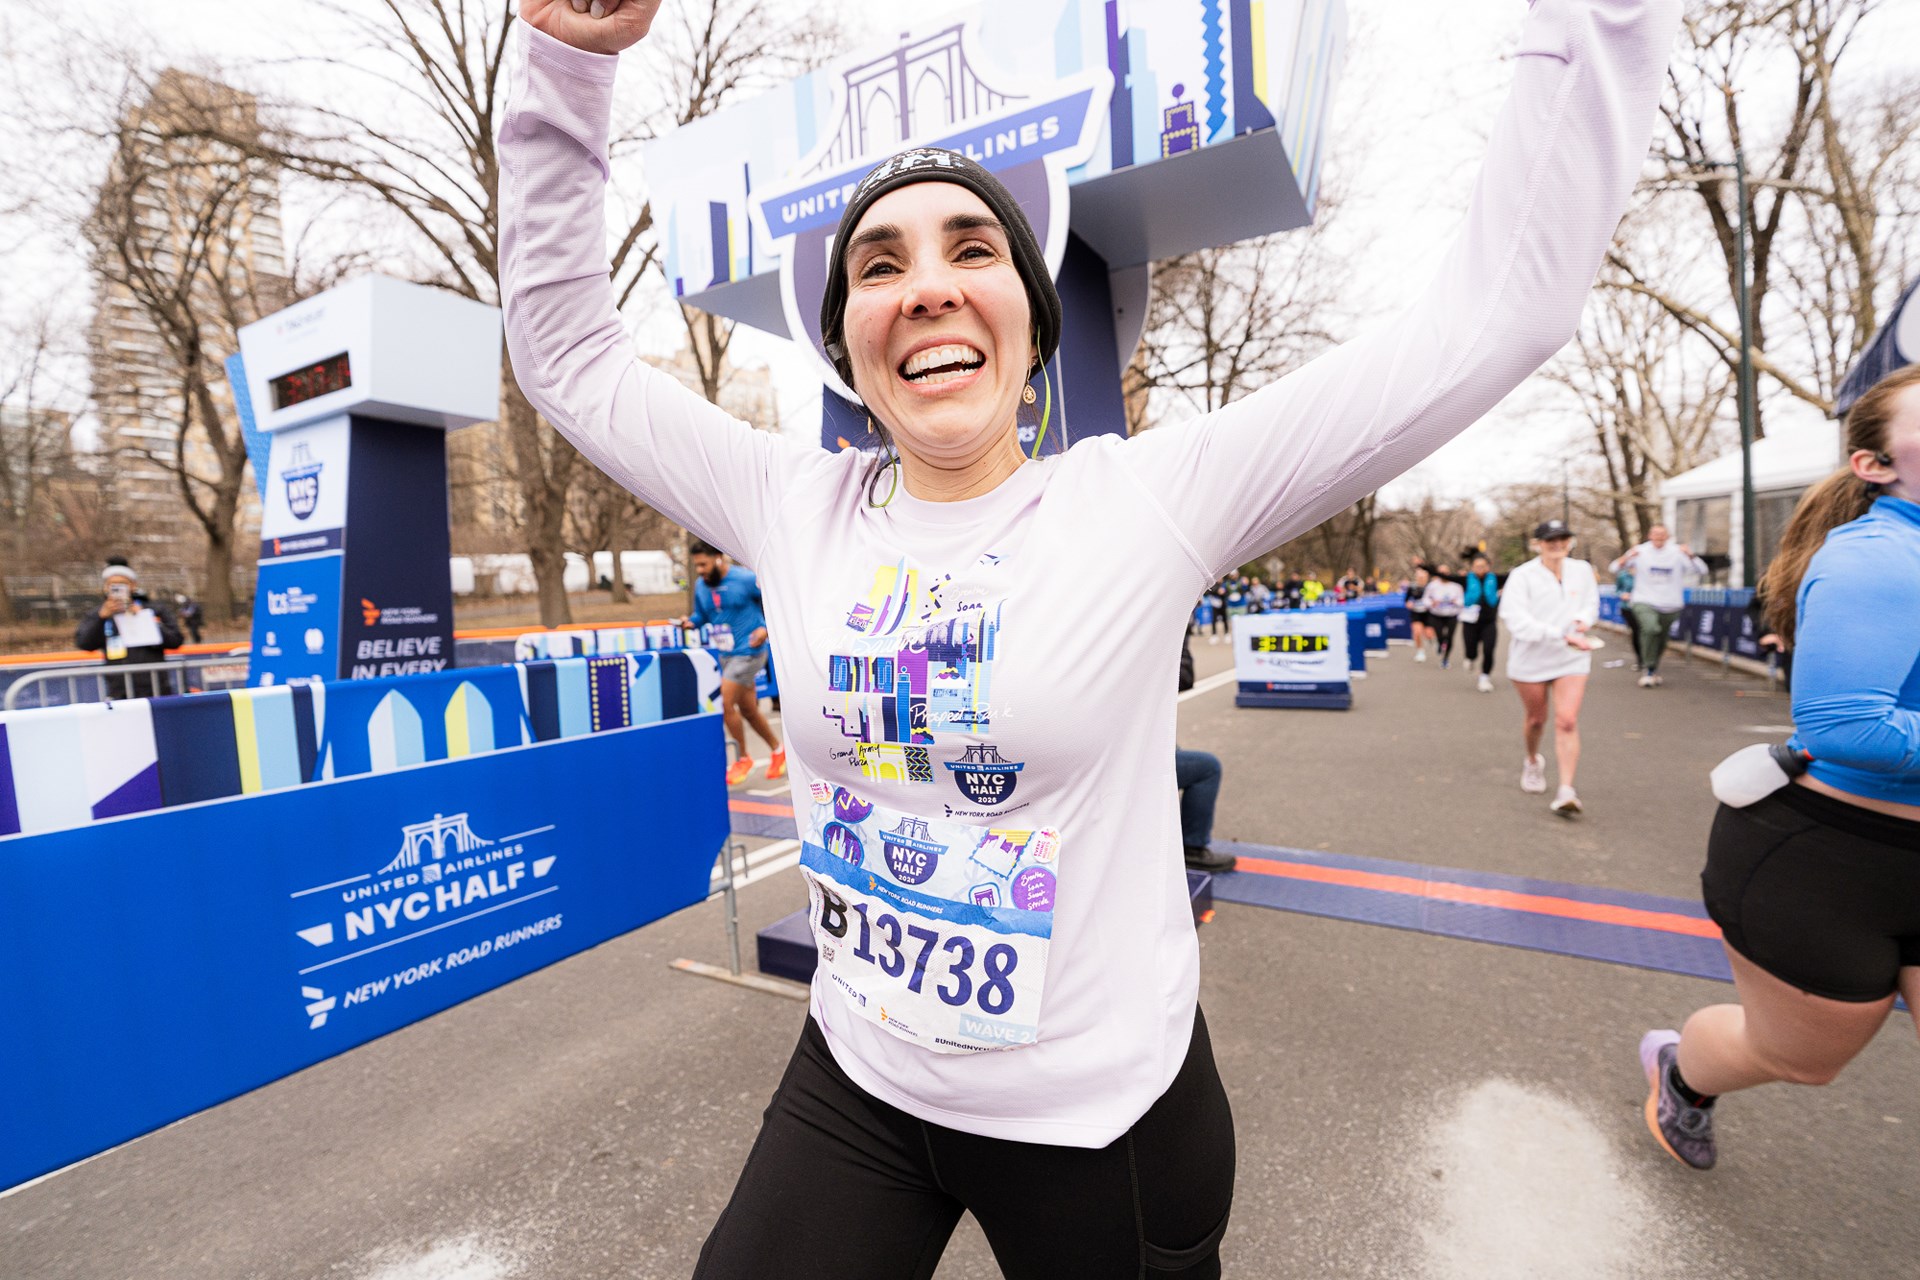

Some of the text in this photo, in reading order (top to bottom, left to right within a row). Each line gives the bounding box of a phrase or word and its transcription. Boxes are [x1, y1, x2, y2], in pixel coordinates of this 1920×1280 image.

[781, 182, 860, 224] UNITE
[950, 115, 1060, 162] LINES
[356, 635, 442, 660] BELIEVE
[351, 658, 447, 681] IN EVERY
[965, 772, 1005, 785] NYC
[970, 785, 1003, 795] HALF
[985, 810, 1002, 818] ROAD
[882, 834, 942, 853] UNITED AIRLINES
[891, 846, 927, 867] NYC
[893, 861, 923, 877] HALF
[342, 843, 524, 903] UNITED AIRLINES
[344, 861, 526, 942] NYC HALF
[877, 885, 943, 914] NEW YORK ROAD RUNNERS
[815, 880, 848, 938] B
[851, 902, 1018, 1015] 13738
[342, 913, 563, 1008] NEW YORK ROAD RUNNERS
[831, 973, 858, 998] UNITED
[965, 1019, 1030, 1044] WAVE 2
